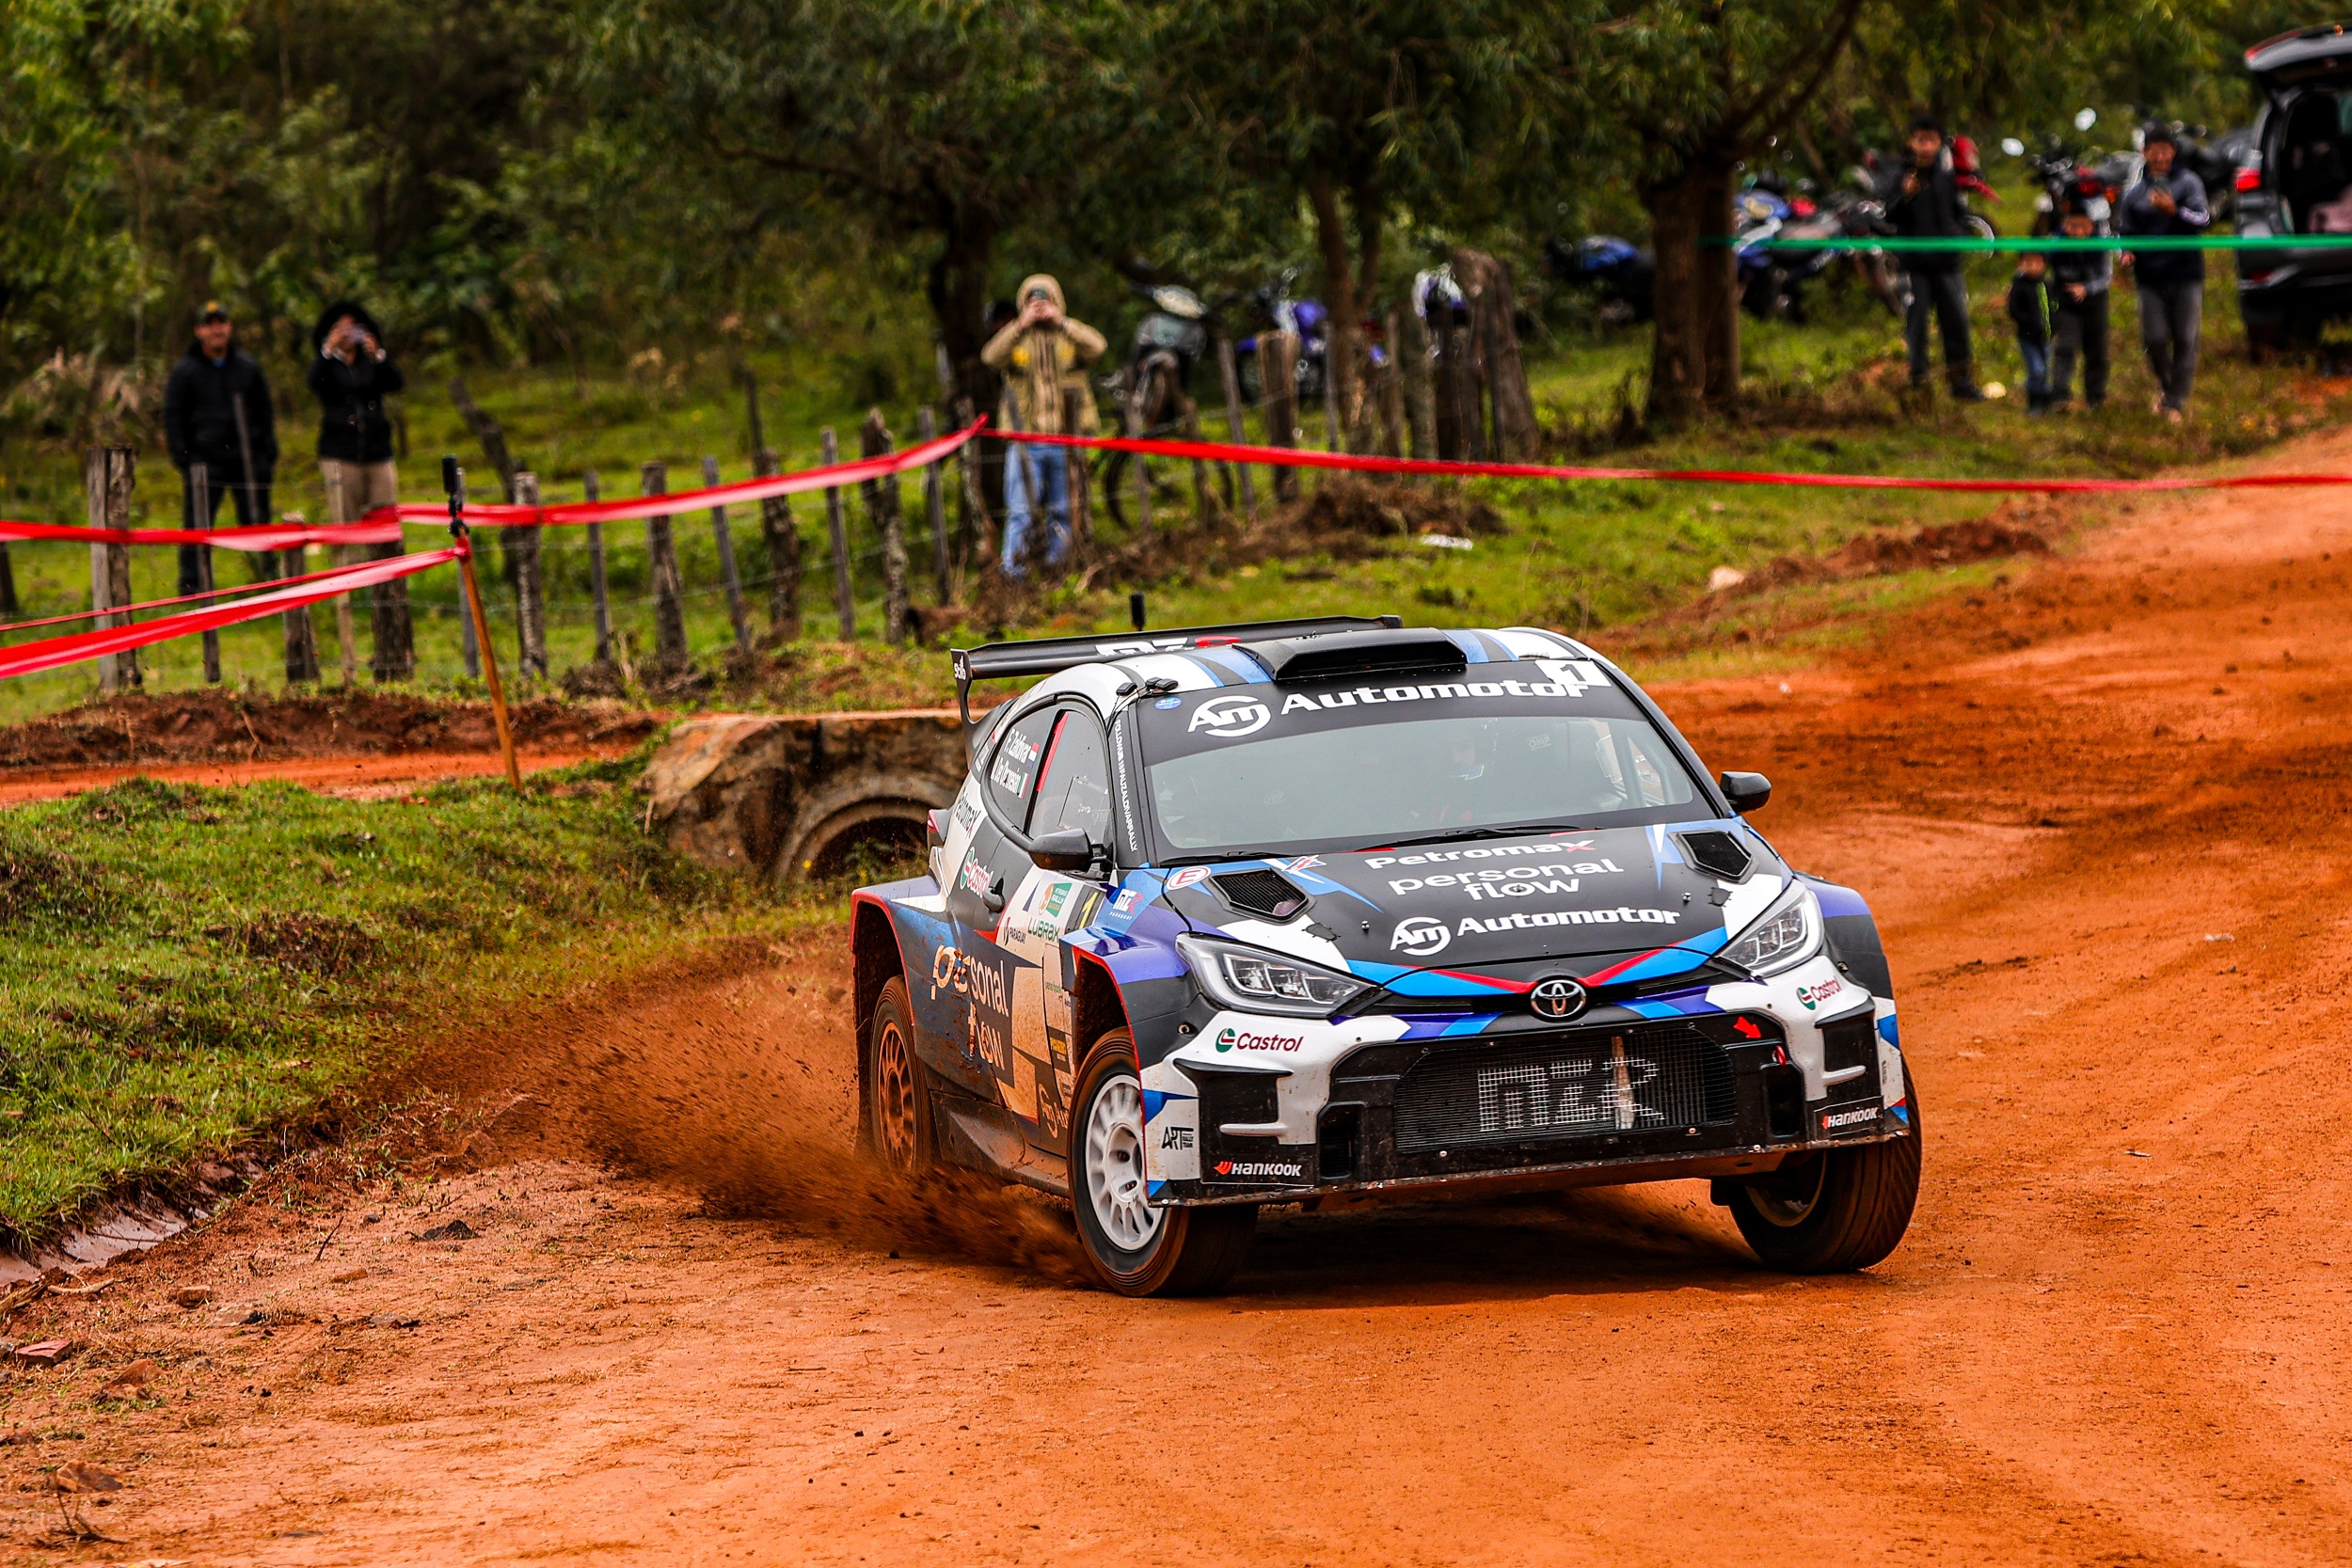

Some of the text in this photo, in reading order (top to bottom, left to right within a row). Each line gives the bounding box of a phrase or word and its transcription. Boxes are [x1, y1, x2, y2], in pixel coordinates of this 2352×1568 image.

[1560, 663, 1587, 682] 1
[1280, 679, 1590, 715] Automotor
[1364, 839, 1597, 870] Petromax
[1176, 870, 1201, 884] E
[1388, 858, 1625, 895] personal
[1464, 879, 1581, 901] flow
[1457, 907, 1680, 937] Automotor
[1237, 1033, 1305, 1052] Castrol
